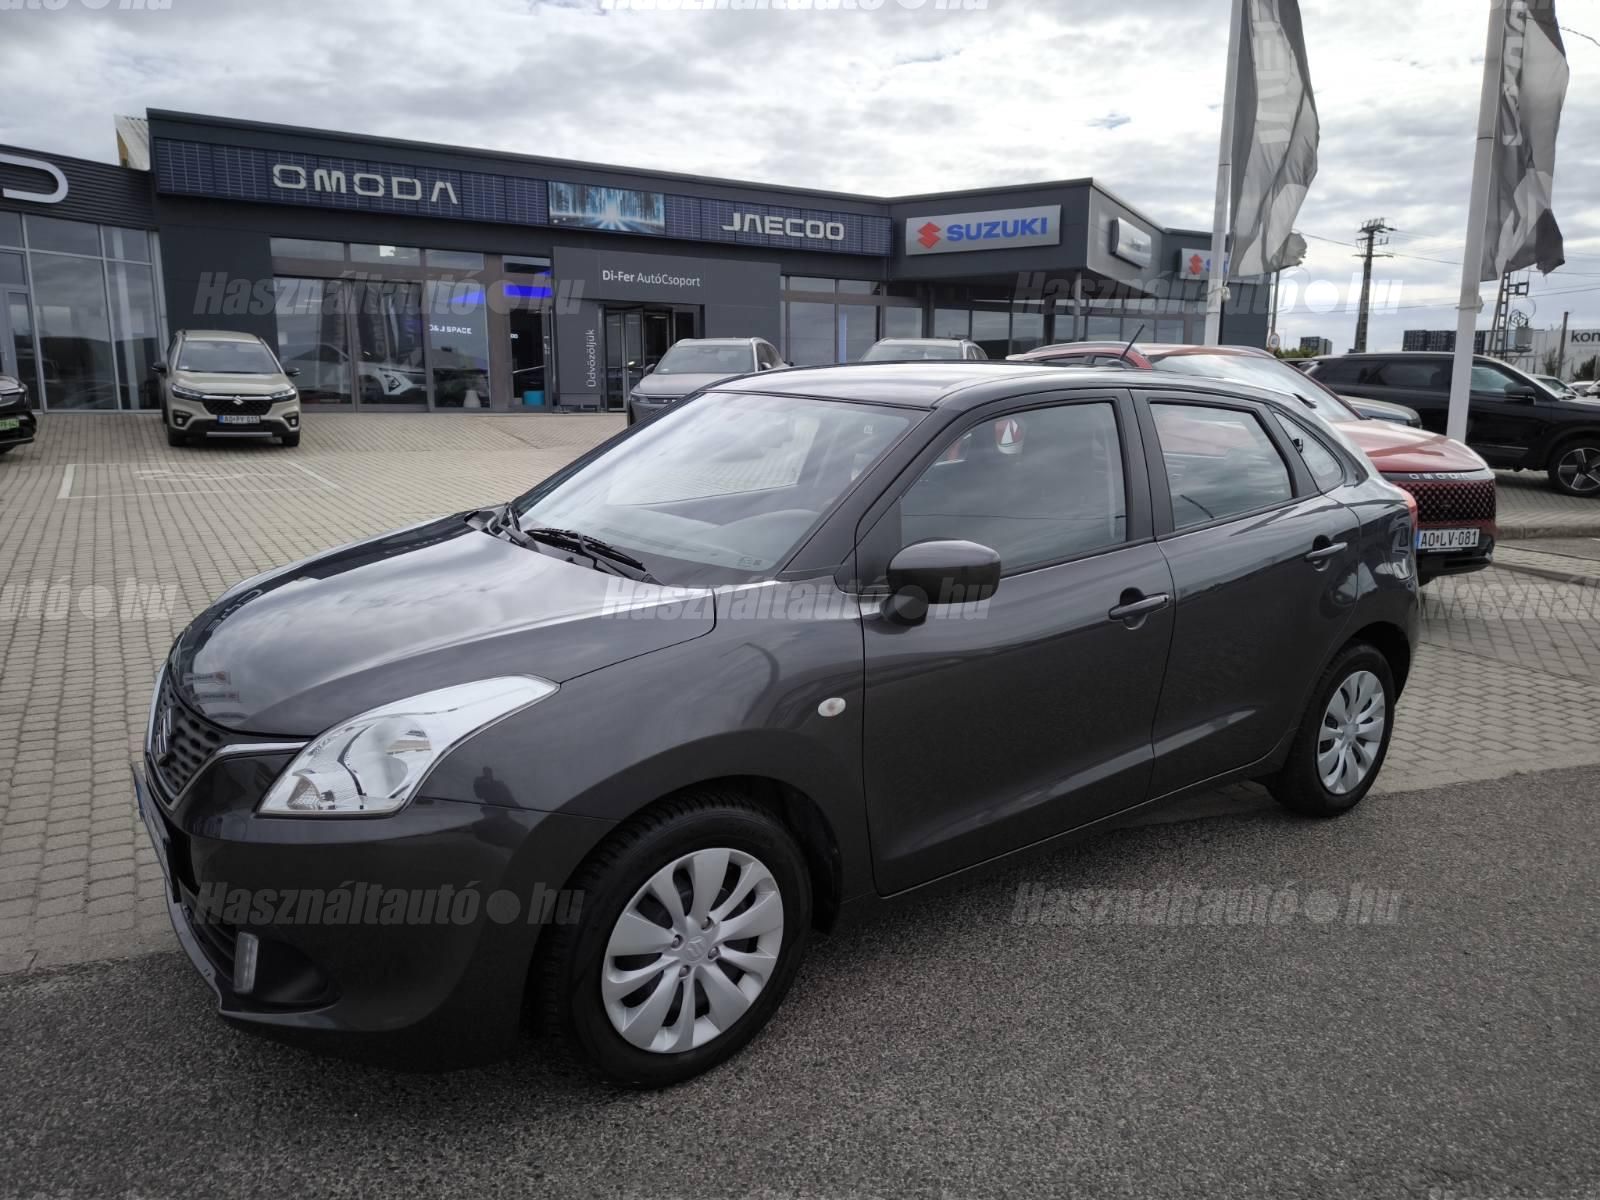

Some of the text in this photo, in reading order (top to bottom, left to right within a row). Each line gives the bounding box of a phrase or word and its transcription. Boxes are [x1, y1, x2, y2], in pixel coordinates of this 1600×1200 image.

[273, 163, 458, 205] OMODA
[722, 212, 845, 241] JAECOO
[946, 216, 1048, 242] SUZUKI
[602, 269, 701, 288] Di-Fer AutóCsoport
[446, 326, 472, 335] SPACE
[585, 329, 597, 387] Üdvözöljük
